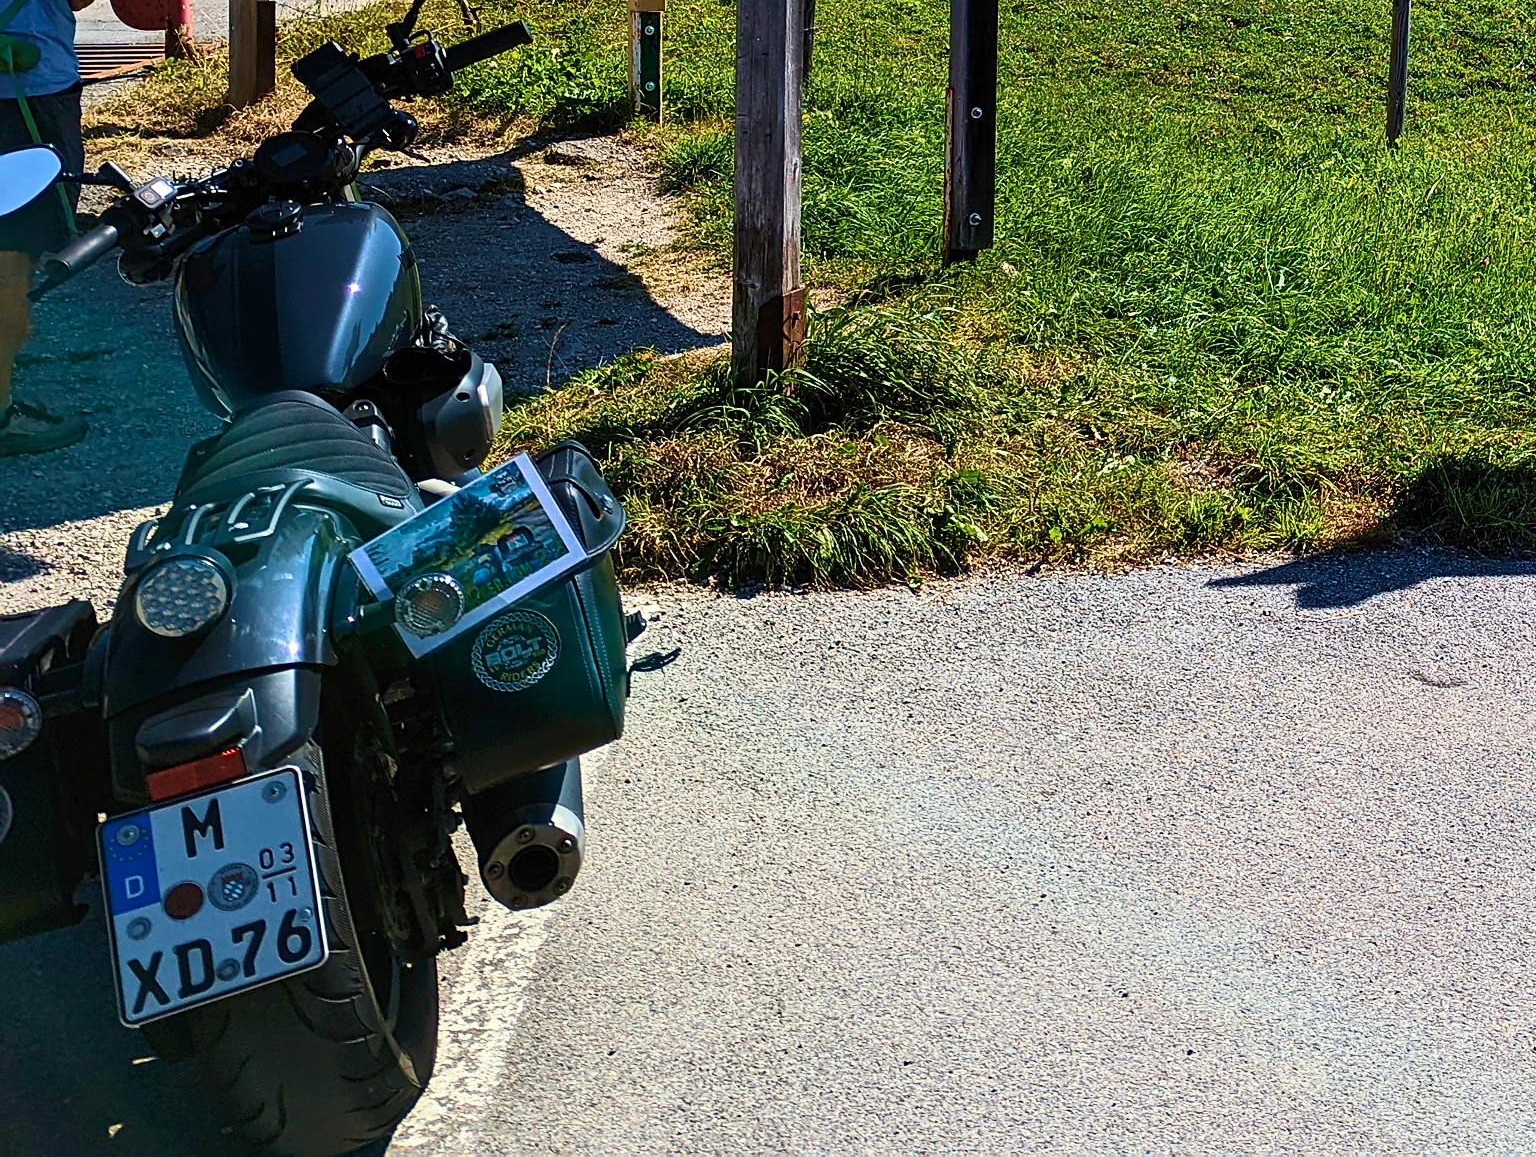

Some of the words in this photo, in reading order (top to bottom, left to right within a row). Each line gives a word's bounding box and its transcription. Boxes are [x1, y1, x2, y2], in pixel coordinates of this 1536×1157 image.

[500, 662, 541, 682] RIDERS
[181, 798, 224, 859] M
[259, 842, 295, 870] 03
[125, 875, 144, 900] D
[266, 876, 297, 902] 11
[127, 938, 216, 1015] XD
[231, 909, 312, 978] 76
